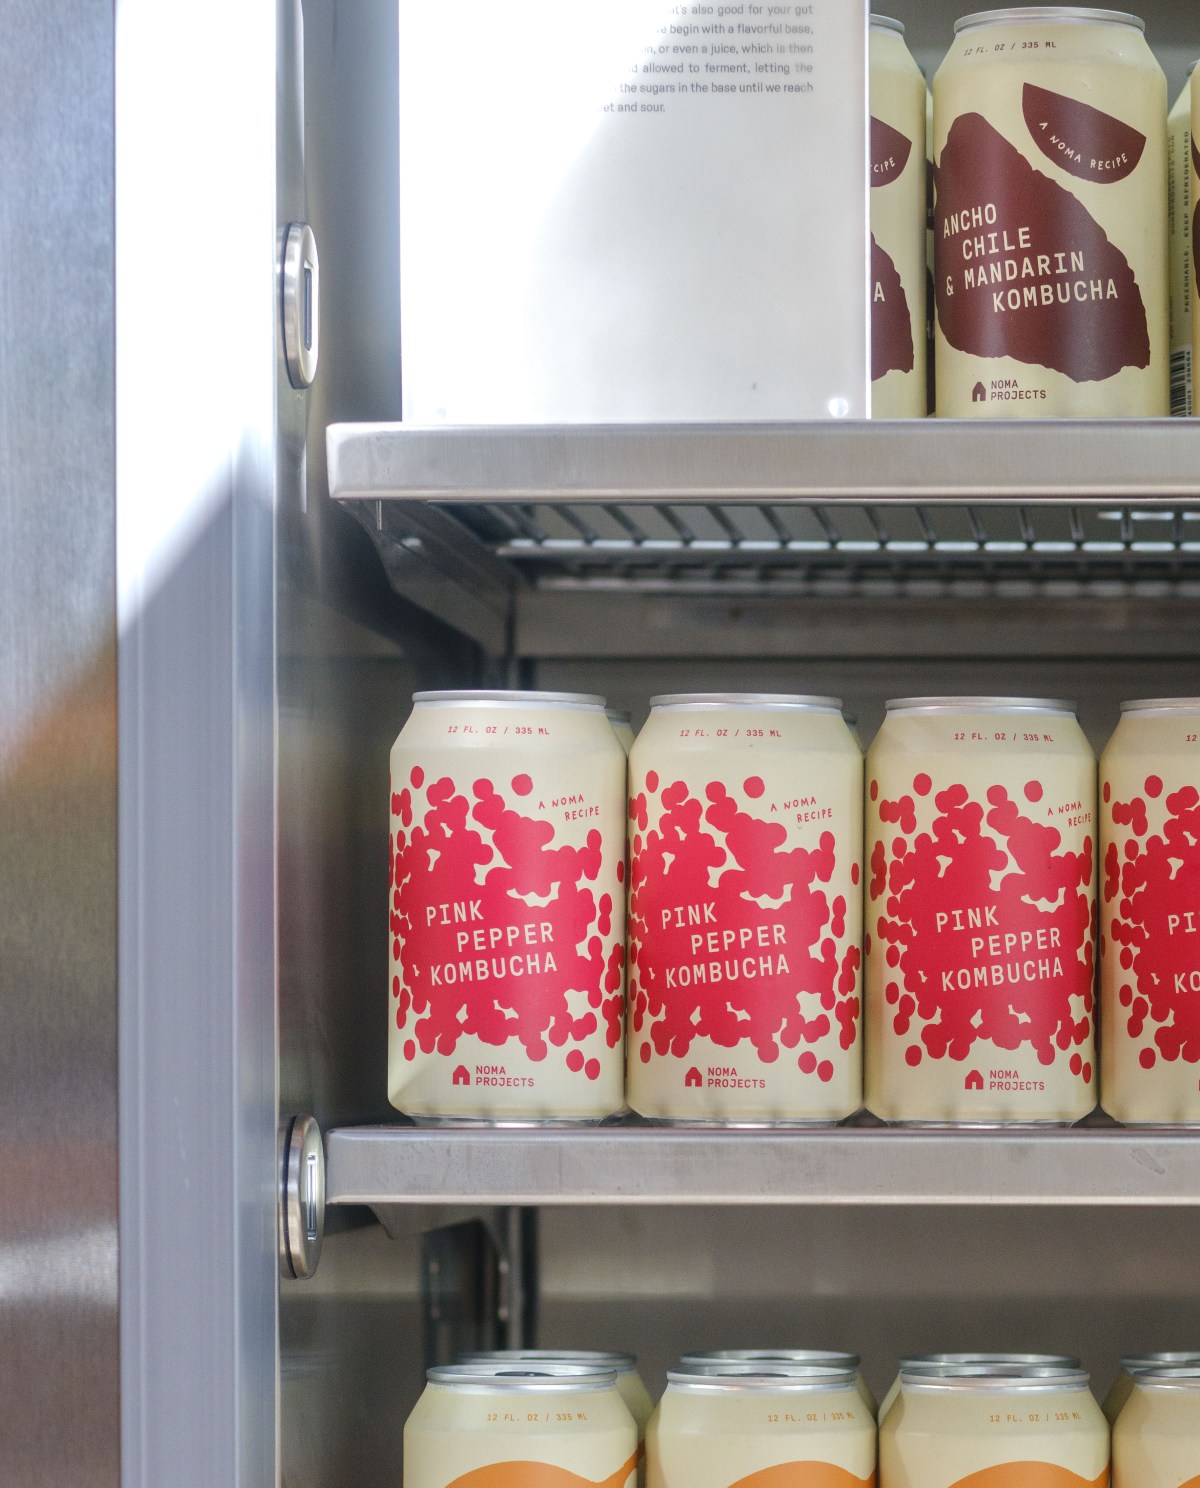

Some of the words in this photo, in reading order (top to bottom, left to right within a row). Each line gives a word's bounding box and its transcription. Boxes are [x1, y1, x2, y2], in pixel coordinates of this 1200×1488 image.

[691, 4, 714, 15] also
[717, 4, 744, 17] good
[749, 4, 763, 15] for
[767, 6, 791, 17] your
[794, 5, 814, 17] gut
[669, 23, 700, 36] begin
[701, 23, 725, 34] with
[728, 26, 734, 34] a
[737, 23, 783, 34] flavorful
[785, 23, 814, 36] base,
[659, 45, 670, 54] or
[672, 45, 698, 54] even
[701, 45, 708, 54] a
[710, 44, 739, 57] juice,
[741, 43, 773, 54] which
[776, 43, 785, 54] is
[789, 43, 813, 54] then
[642, 62, 684, 74] allowed
[688, 64, 700, 74] to
[705, 62, 750, 75] ferment,
[755, 62, 790, 75] letting
[795, 62, 813, 74] the
[619, 82, 637, 93] the
[639, 84, 675, 96] sugars
[678, 82, 688, 93] in
[690, 82, 708, 93] the
[711, 82, 737, 93] base
[739, 82, 763, 93] until
[765, 84, 781, 93] we
[783, 82, 813, 93] reach
[617, 102, 638, 113] and
[640, 104, 666, 113] sour.
[1039, 121, 1049, 130] A
[1050, 135, 1082, 163] NOMA
[1090, 152, 1129, 171] RECIPE
[871, 156, 896, 173] CIPE
[942, 202, 998, 240] ANCHO
[962, 226, 1032, 261] CHILE
[946, 275, 954, 297] &
[964, 250, 1085, 290] MANDARIN
[993, 278, 1118, 314] KOMBUCHA
[991, 379, 1019, 389] NOMA
[990, 388, 1047, 401] PROJECTS
[538, 800, 546, 810] A
[552, 794, 585, 809] NOMA
[564, 806, 600, 822] RECIPE
[426, 899, 484, 927] PINK
[661, 902, 717, 930] PINK
[935, 905, 999, 933] PINK
[456, 922, 554, 953] PEPPER
[690, 924, 787, 955] PEPPER
[971, 927, 1062, 959] PEPPER
[430, 952, 558, 986] KOMBUCHA
[665, 953, 790, 989] KOMBUCHA
[941, 956, 1064, 992] KOMBUCHA
[475, 1065, 507, 1075] NOMA
[707, 1067, 738, 1077] NOMA
[989, 1070, 1019, 1080] NOMA
[475, 1076, 535, 1088] PROJECTS
[707, 1078, 766, 1089] PROJECTS
[989, 1081, 1045, 1091] PROJECTS
